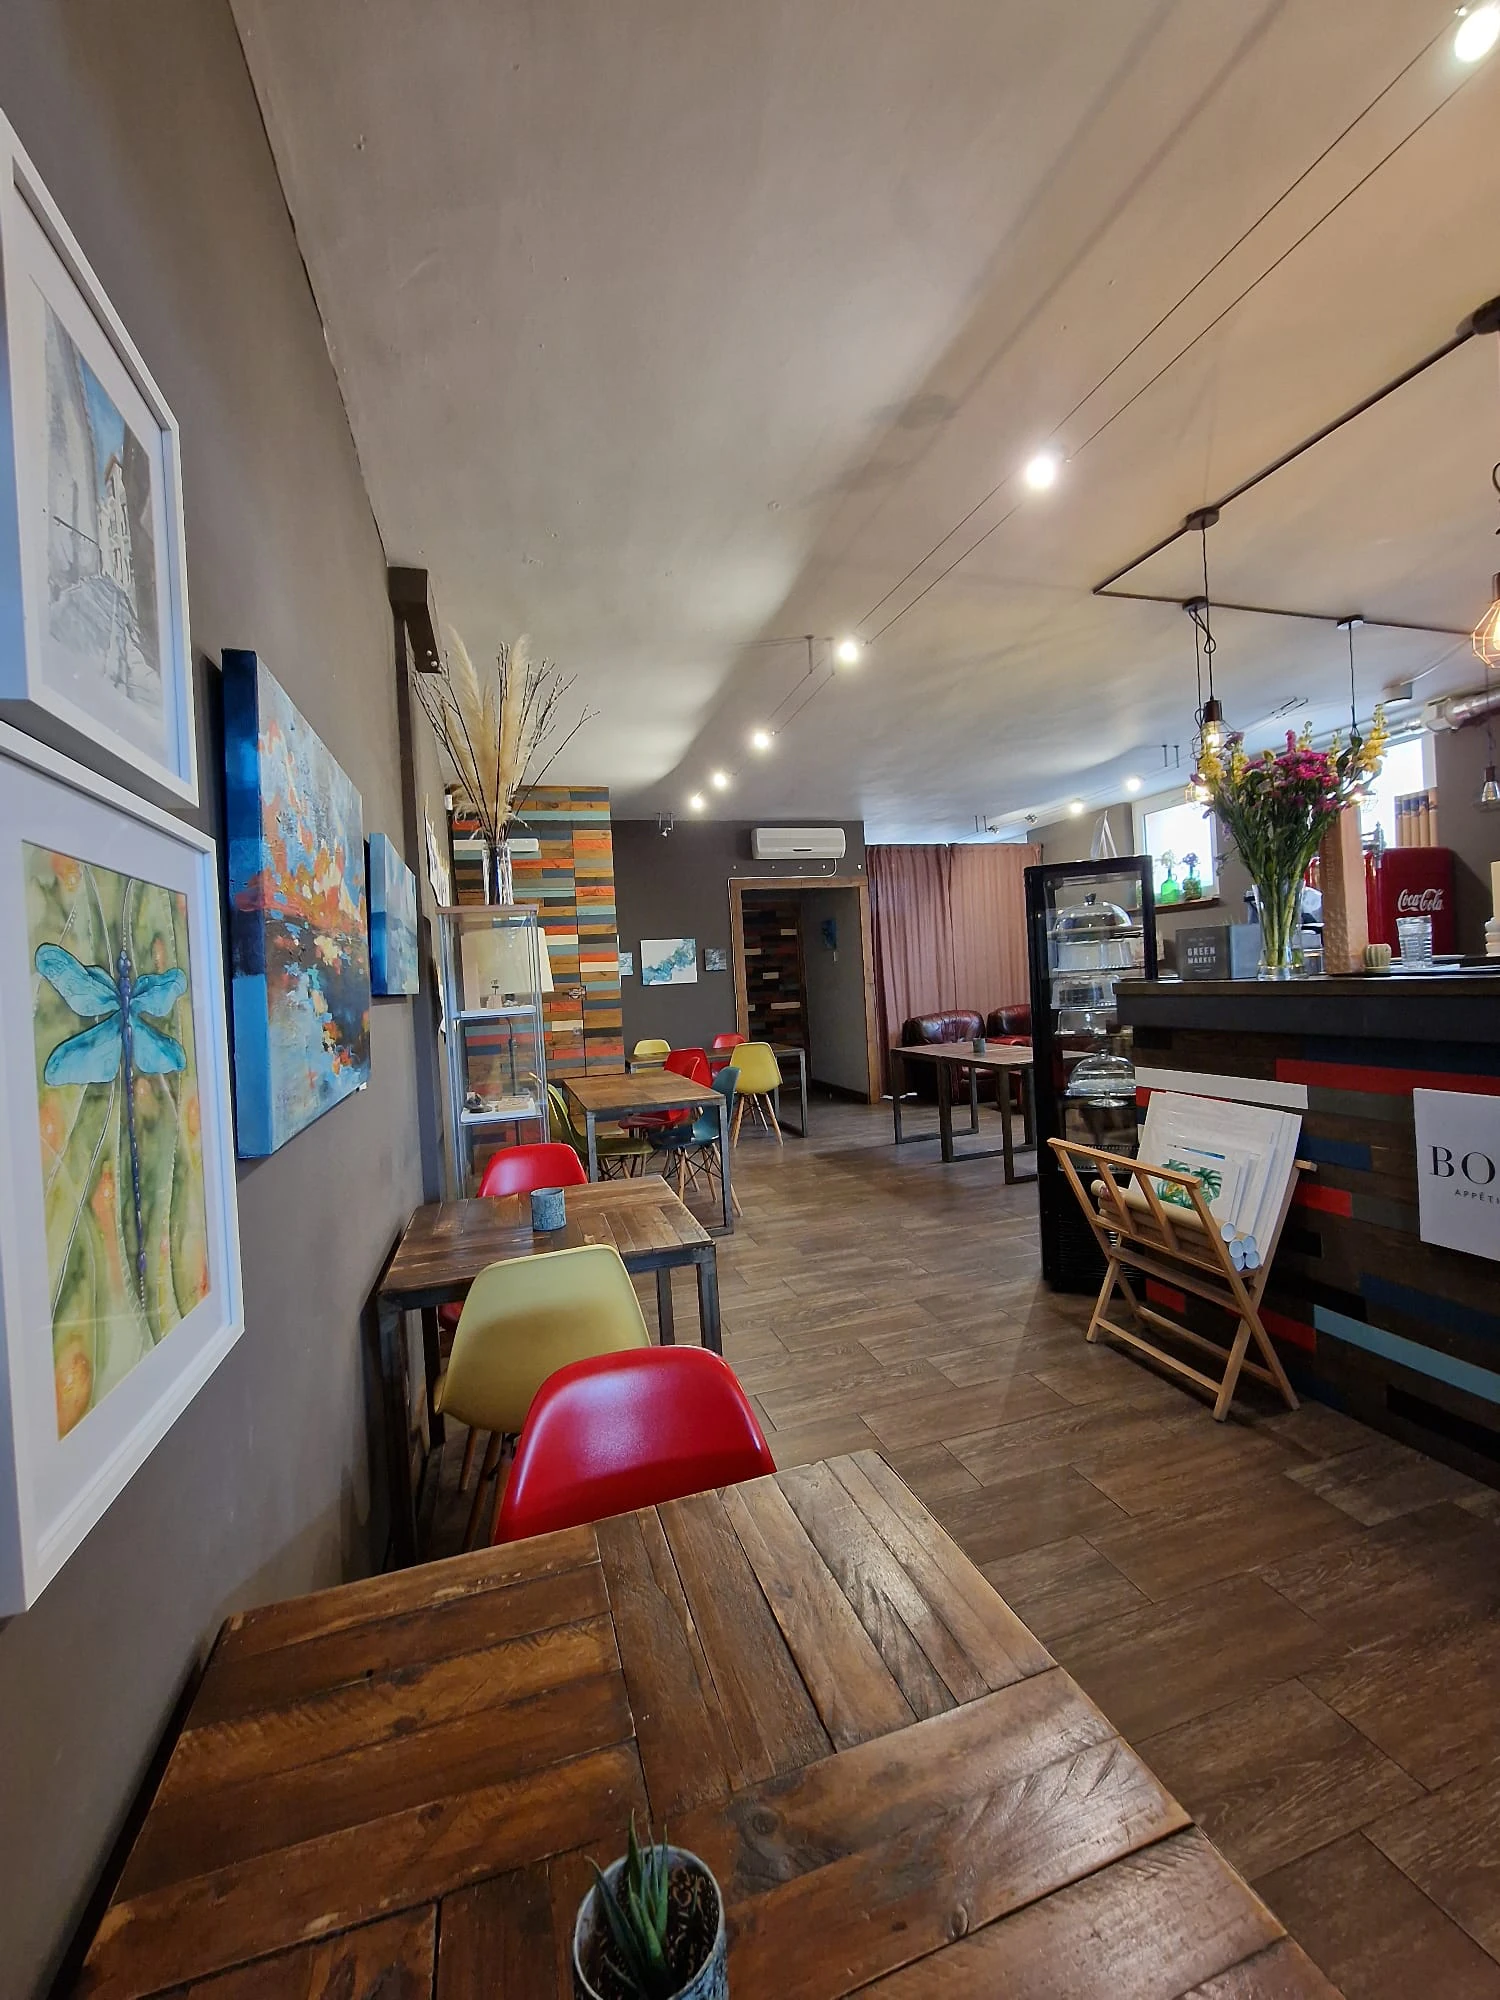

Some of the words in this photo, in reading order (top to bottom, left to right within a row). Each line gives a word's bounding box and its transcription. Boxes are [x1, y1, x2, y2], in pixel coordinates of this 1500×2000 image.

[1397, 888, 1444, 912] Coca-Cola
[1187, 946, 1216, 957] GREEN
[1187, 956, 1217, 964] MARKET
